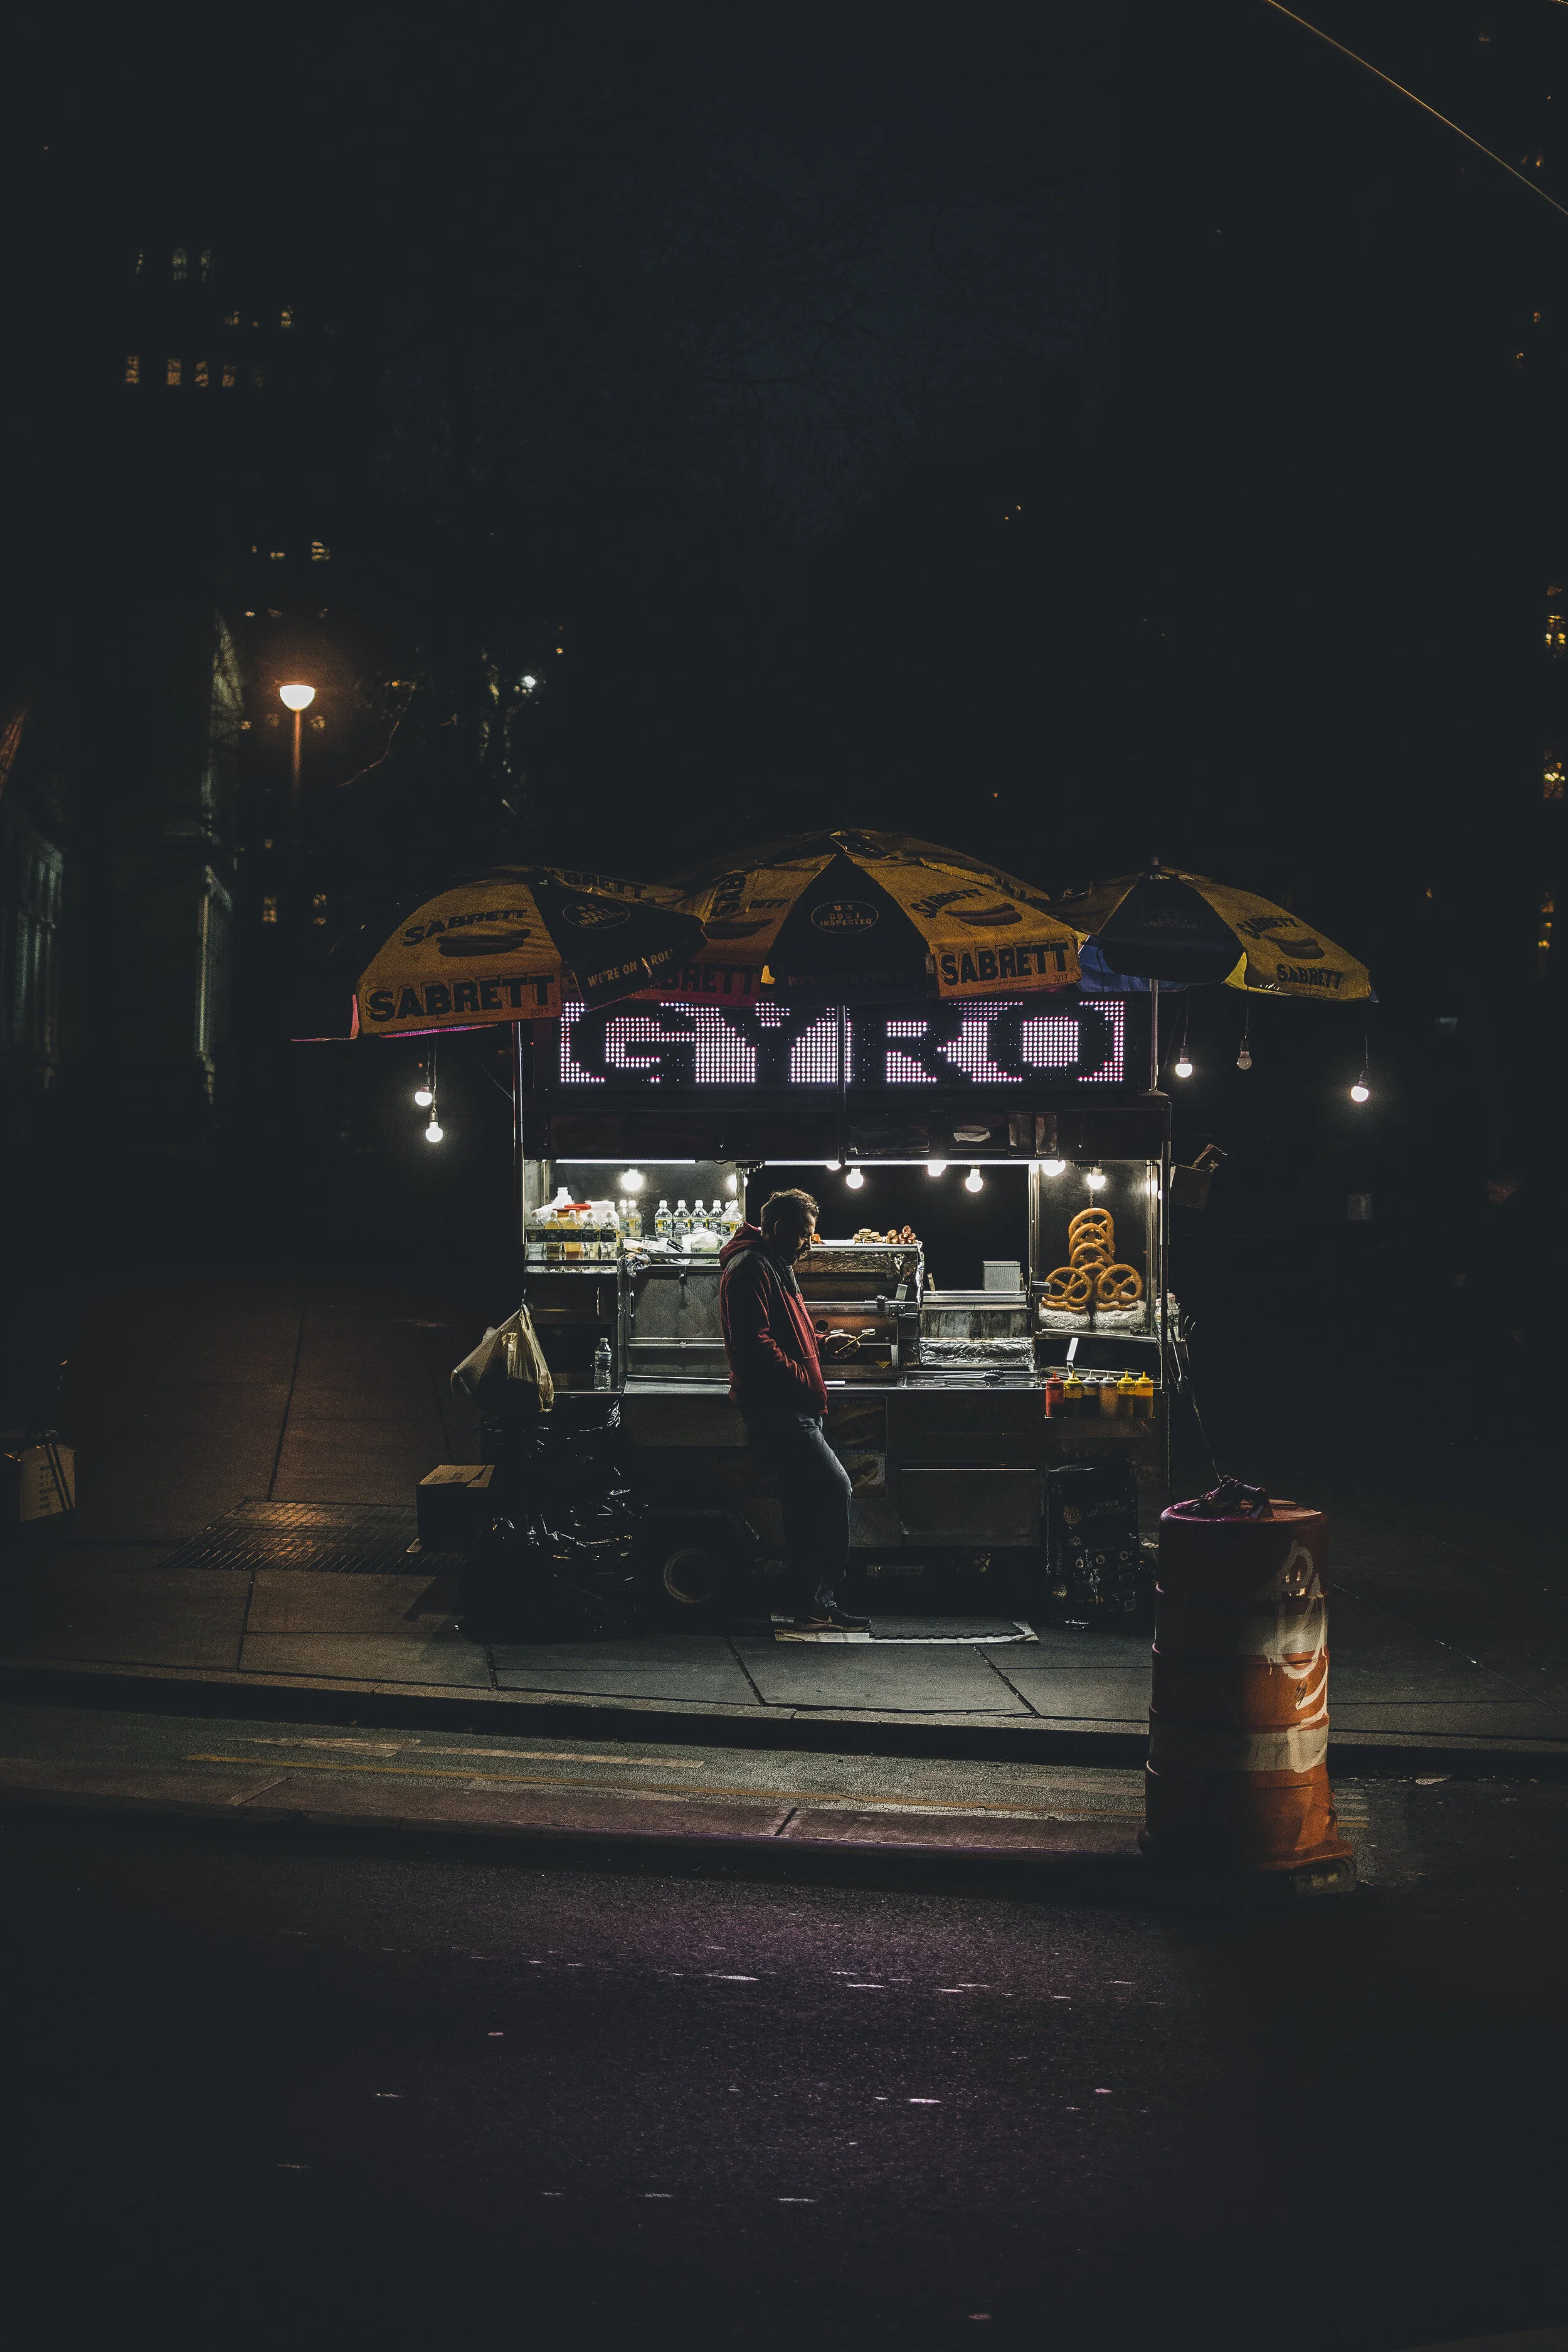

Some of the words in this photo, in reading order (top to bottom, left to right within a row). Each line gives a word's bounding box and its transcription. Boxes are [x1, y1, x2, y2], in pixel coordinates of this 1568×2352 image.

[911, 888, 983, 918] SABRETT
[400, 909, 527, 946] SABRETT
[820, 918, 872, 926] INSPECTED
[587, 967, 620, 988] WE'RE
[622, 961, 638, 975] ON
[940, 940, 1068, 985] SABRETT
[1274, 961, 1343, 989] SABRETT
[1054, 974, 1068, 982] 2017
[366, 972, 554, 1022] SABRETT
[531, 1007, 549, 1016] 2017
[568, 1002, 1116, 1084] GYRO
